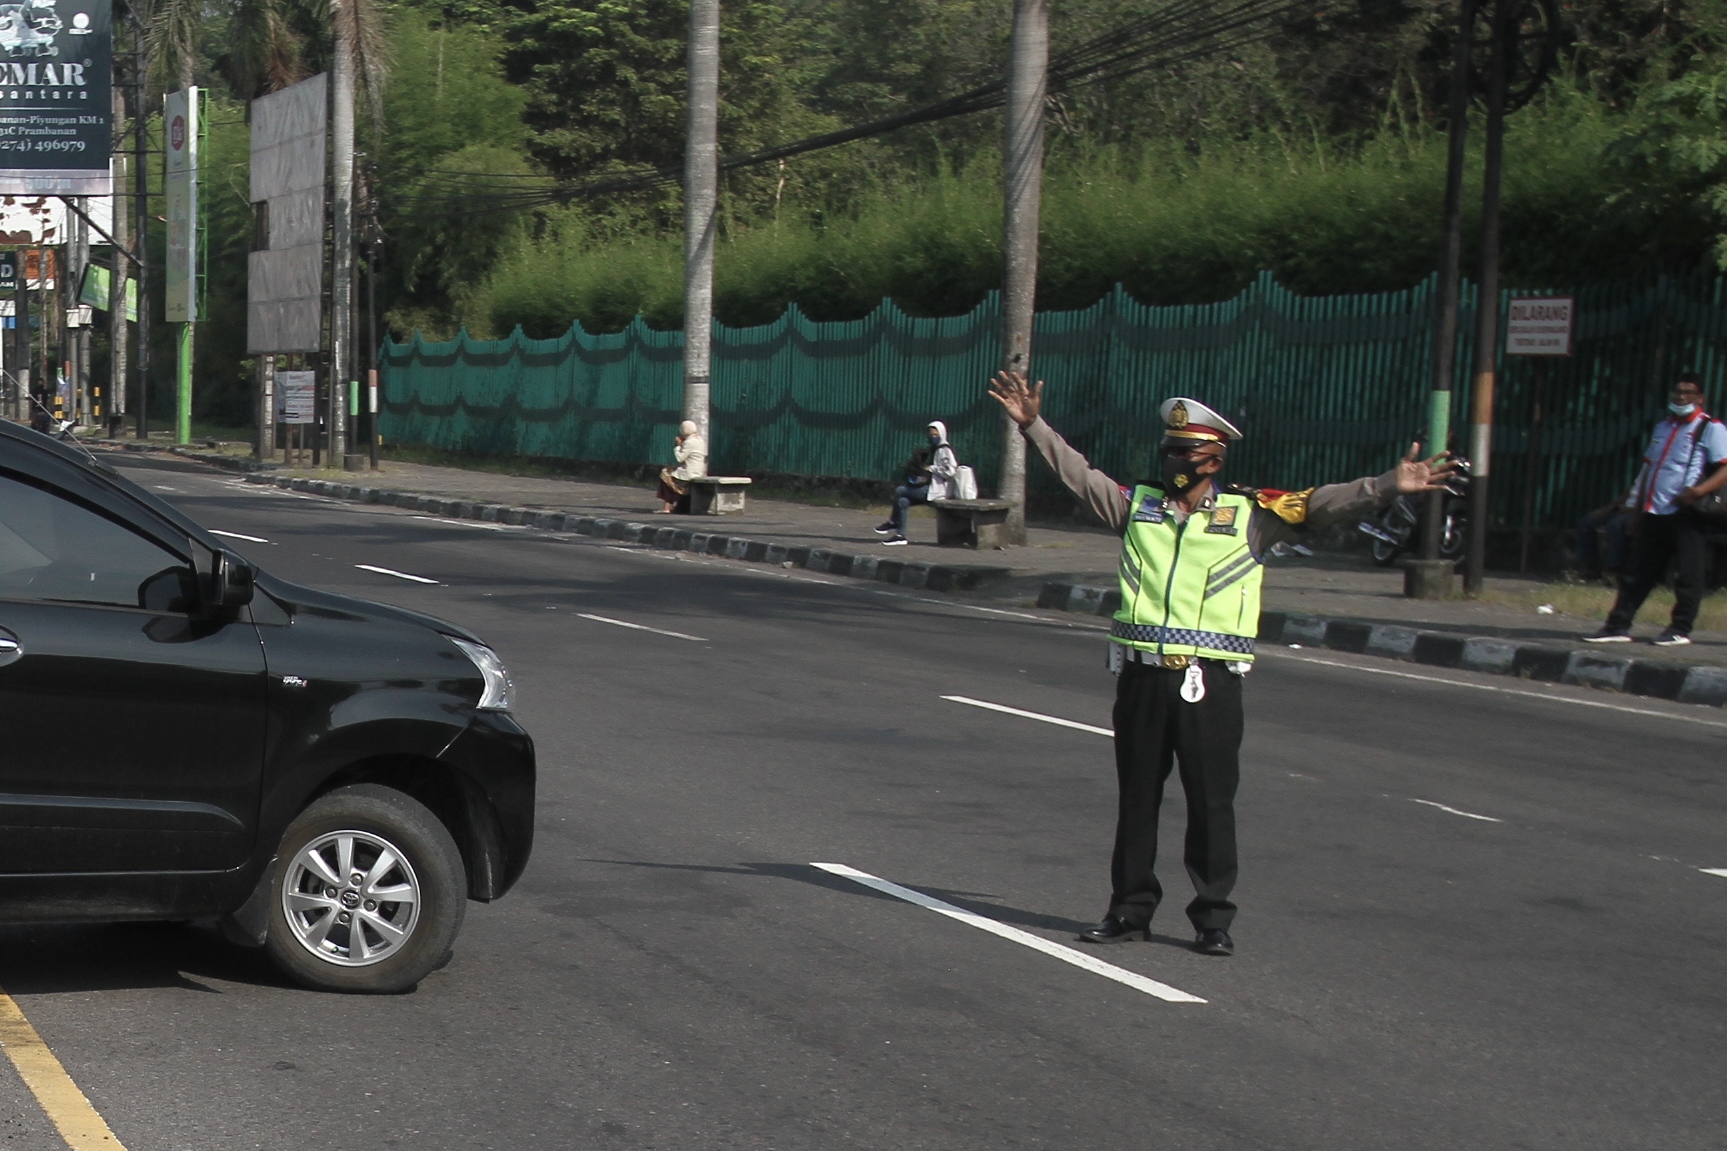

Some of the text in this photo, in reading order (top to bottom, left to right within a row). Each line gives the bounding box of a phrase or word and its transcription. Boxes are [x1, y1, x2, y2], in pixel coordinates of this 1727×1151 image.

[79, 116, 97, 124] KM
[18, 126, 76, 135] Prambanan
[34, 140, 86, 151] 496979
[1511, 305, 1569, 321] DILARANG
